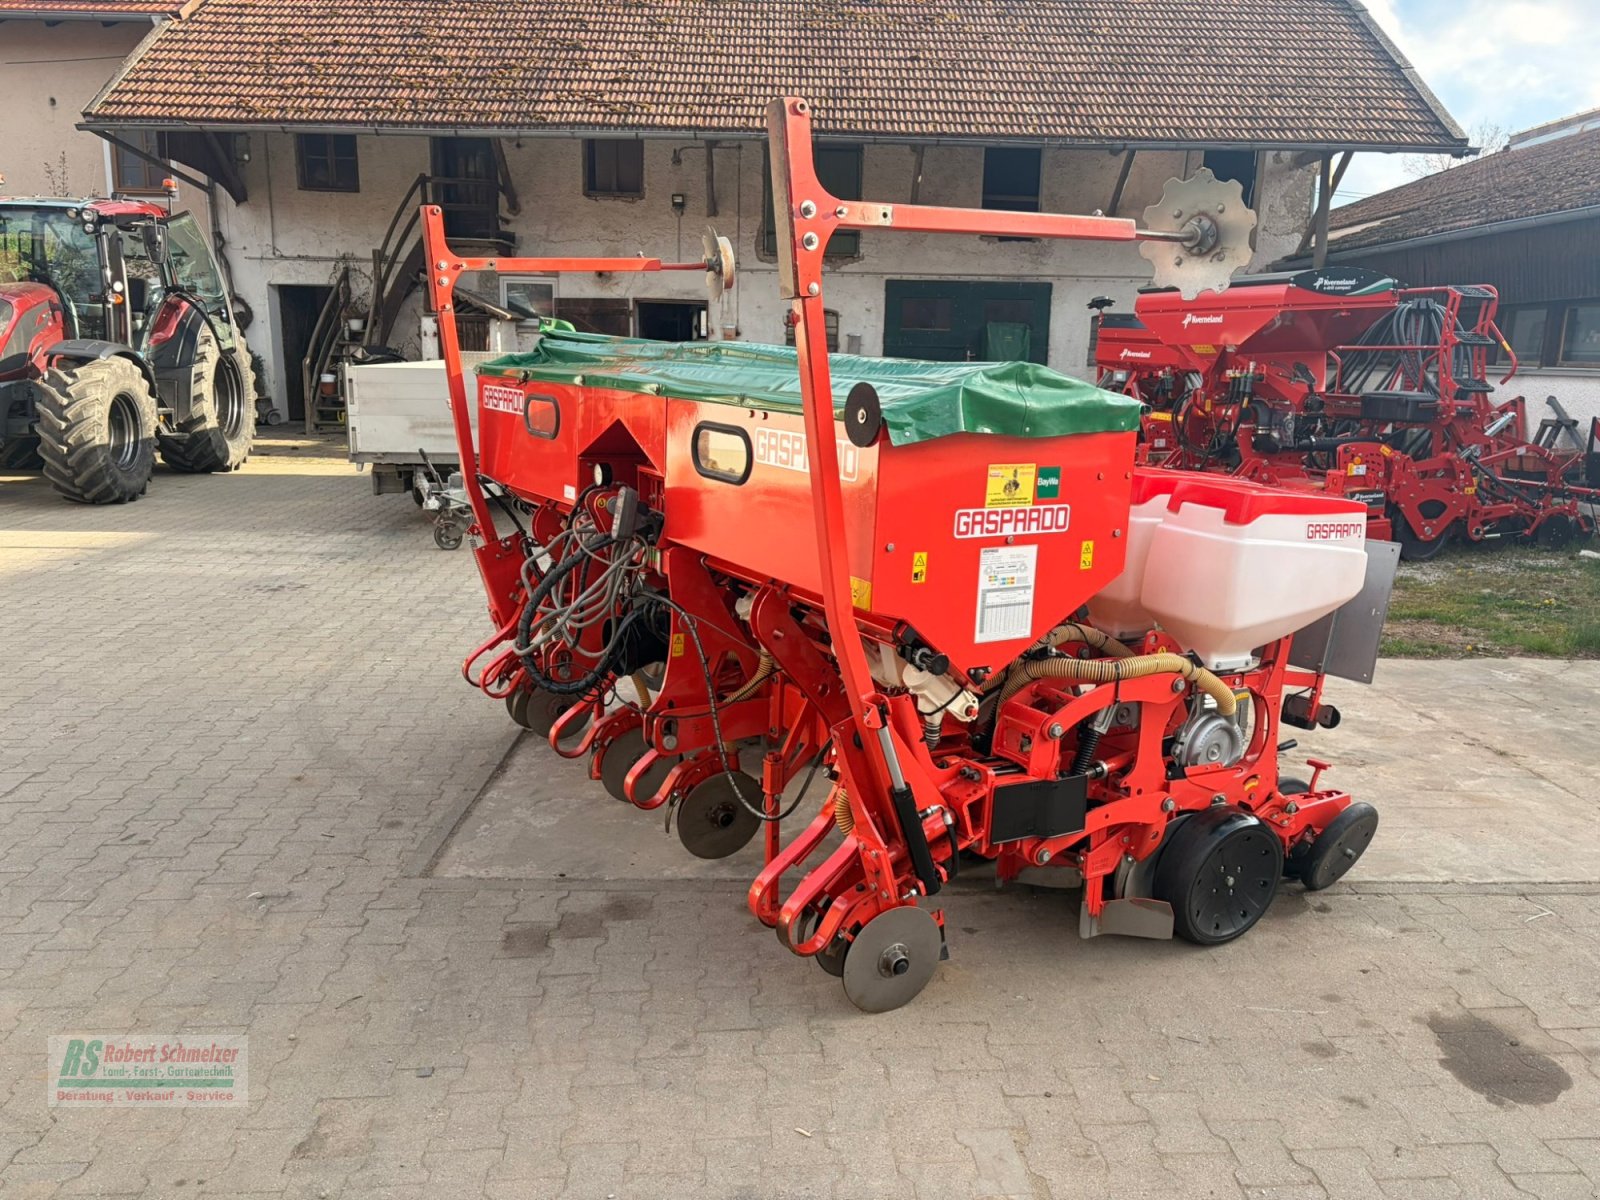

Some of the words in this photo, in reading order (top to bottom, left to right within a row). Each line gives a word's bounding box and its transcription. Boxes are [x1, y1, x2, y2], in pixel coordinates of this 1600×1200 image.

[1191, 314, 1223, 324] Kverneland
[484, 387, 523, 412] GASPARDO
[1037, 477, 1059, 487] BayWa
[956, 506, 1069, 537] GASPARDO
